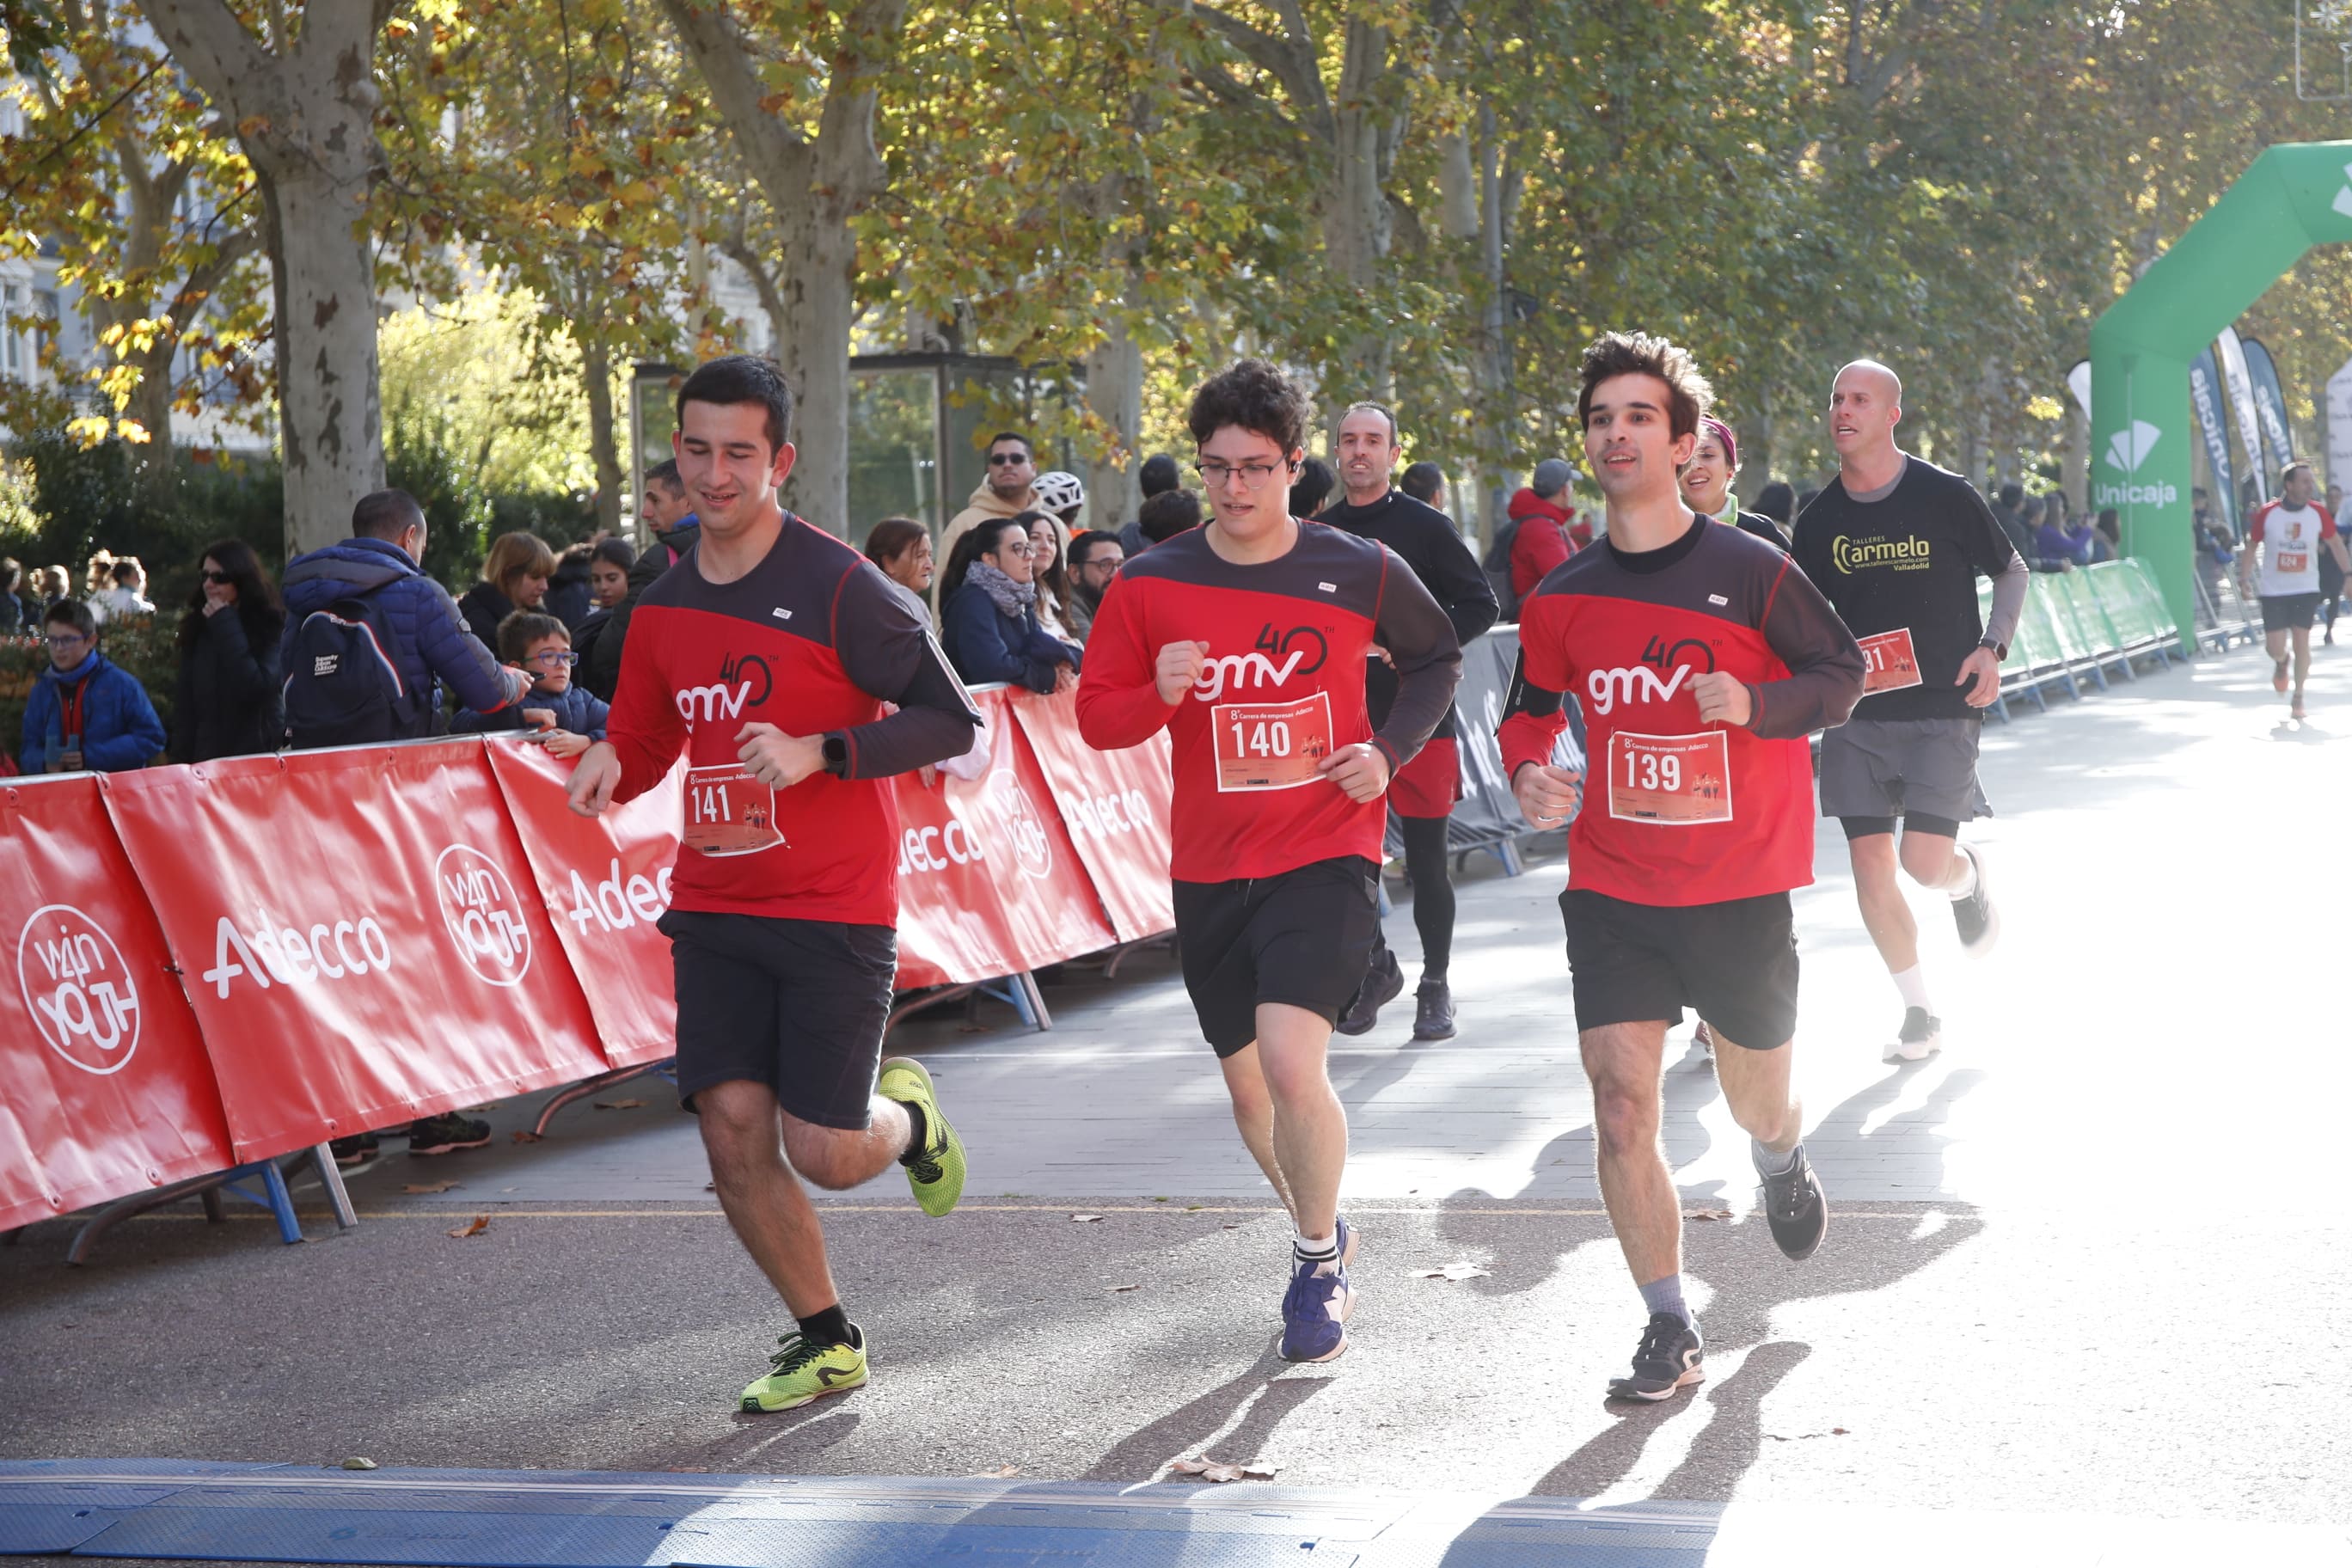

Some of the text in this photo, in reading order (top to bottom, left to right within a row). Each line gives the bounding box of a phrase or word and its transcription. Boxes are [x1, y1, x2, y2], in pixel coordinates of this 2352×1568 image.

[2095, 481, 2177, 509] Unicaja
[1832, 535, 1930, 574] Carmelo
[1853, 536, 1885, 545] TALLERES
[1854, 557, 1929, 569] www.tallerescarmelo.com
[1893, 562, 1930, 571] Valladolid
[1194, 650, 1304, 701] gmv
[1862, 646, 1884, 673] 91
[676, 680, 752, 734] gmv
[1588, 664, 1691, 715] gmv
[1267, 712, 1293, 720] empresas
[1295, 706, 1314, 715] Adecco
[1231, 720, 1290, 758] 140
[1687, 742, 1709, 751] Adecco
[1625, 750, 1681, 792] 139
[691, 784, 731, 824] 141
[897, 818, 985, 875] ecco
[568, 857, 672, 936] Adec
[202, 907, 391, 1000] Adecco
[37, 981, 139, 1050] YOUTH
